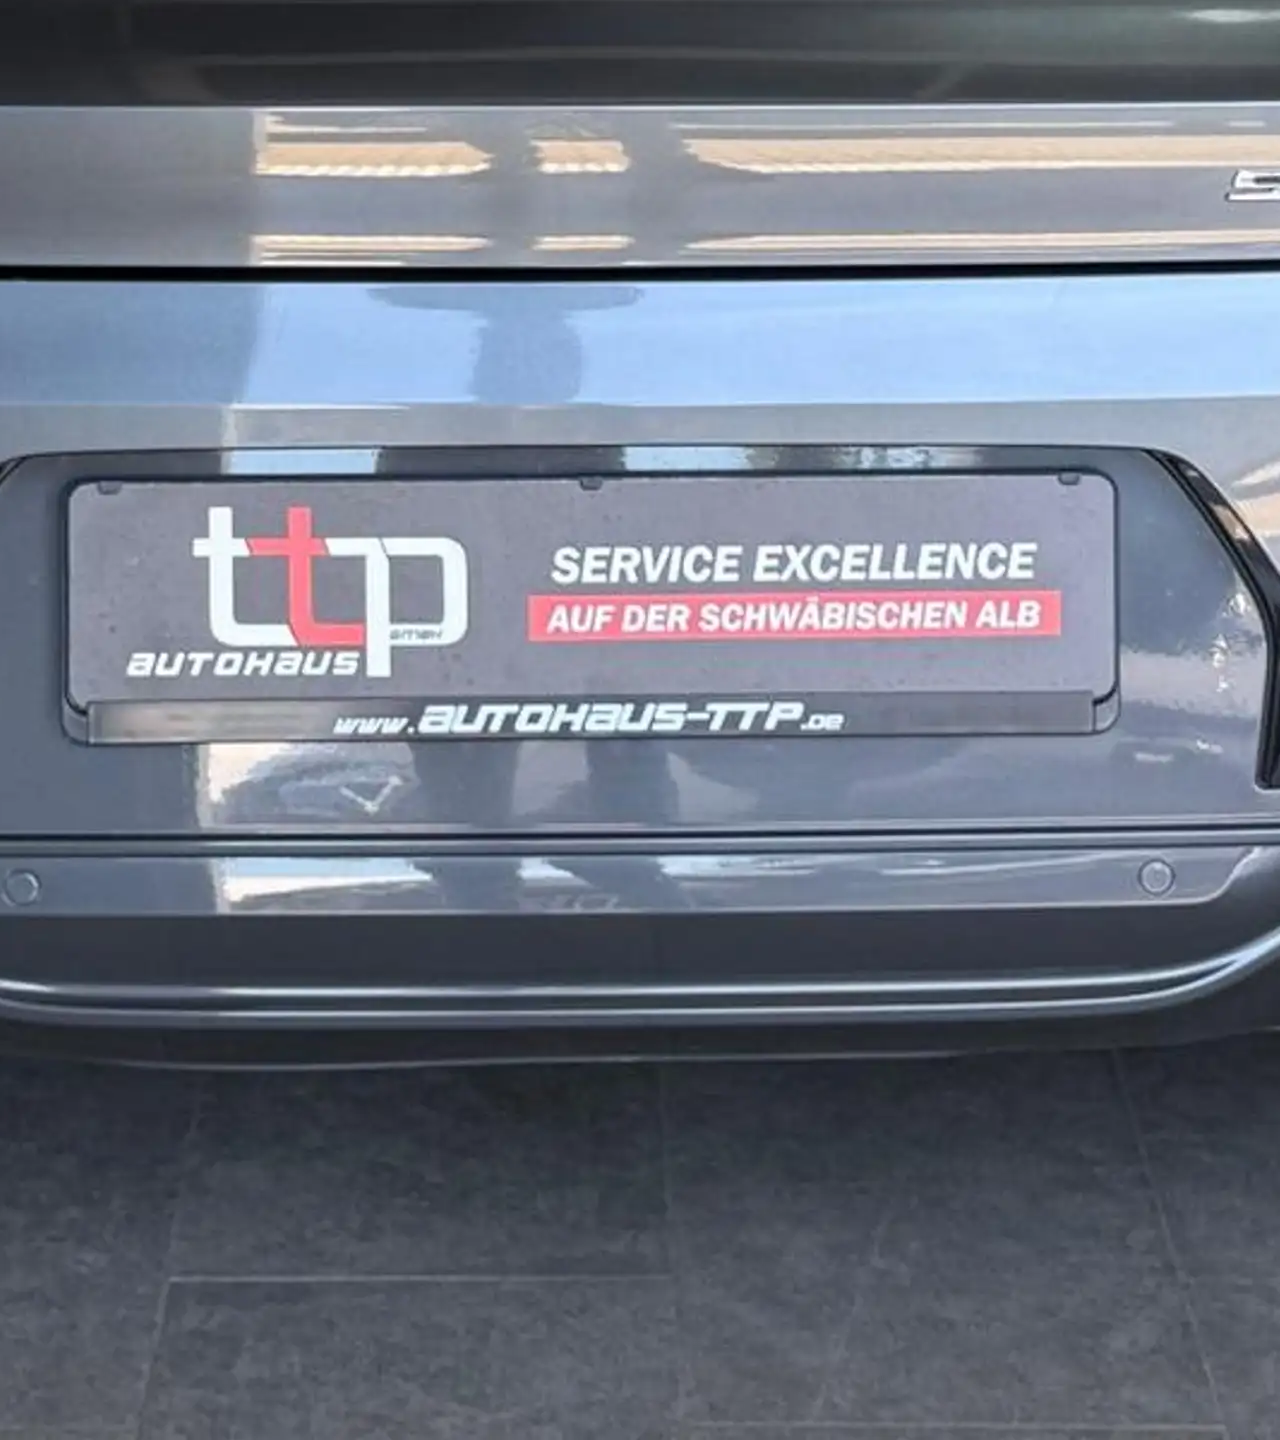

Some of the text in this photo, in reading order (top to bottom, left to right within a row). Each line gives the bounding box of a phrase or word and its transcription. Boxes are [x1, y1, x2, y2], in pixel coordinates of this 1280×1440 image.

[551, 543, 1038, 584] SERVICE EXCELLENCE
[547, 597, 1041, 634] AUF DER SCHWÄBISCHEN ALB
